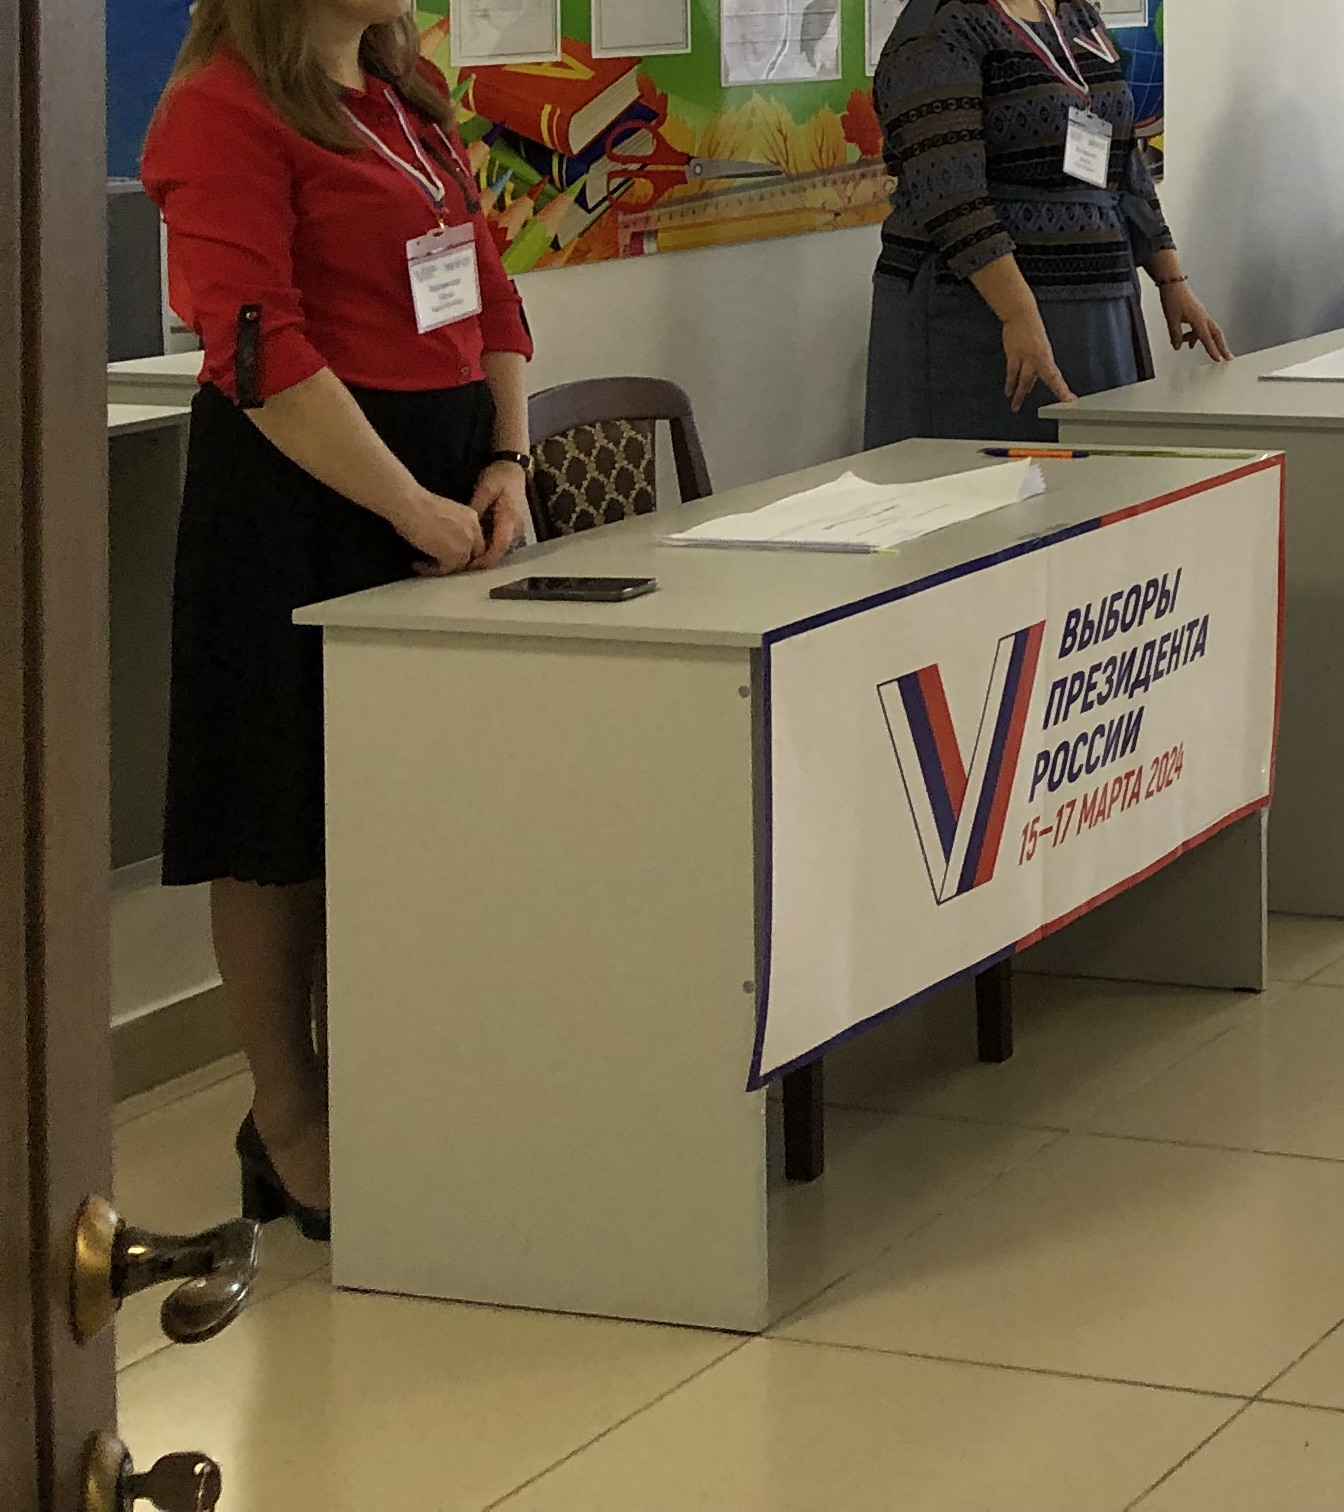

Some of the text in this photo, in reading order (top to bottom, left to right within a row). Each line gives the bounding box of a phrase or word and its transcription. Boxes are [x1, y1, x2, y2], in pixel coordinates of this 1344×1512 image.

[1057, 566, 1183, 660] ВЫБОРЫ
[1042, 613, 1210, 730] ПРЕЗИДЕНТА
[1028, 705, 1146, 804] РОССИИ
[1076, 764, 1144, 837] МАРТА
[1144, 742, 1185, 801] 2024
